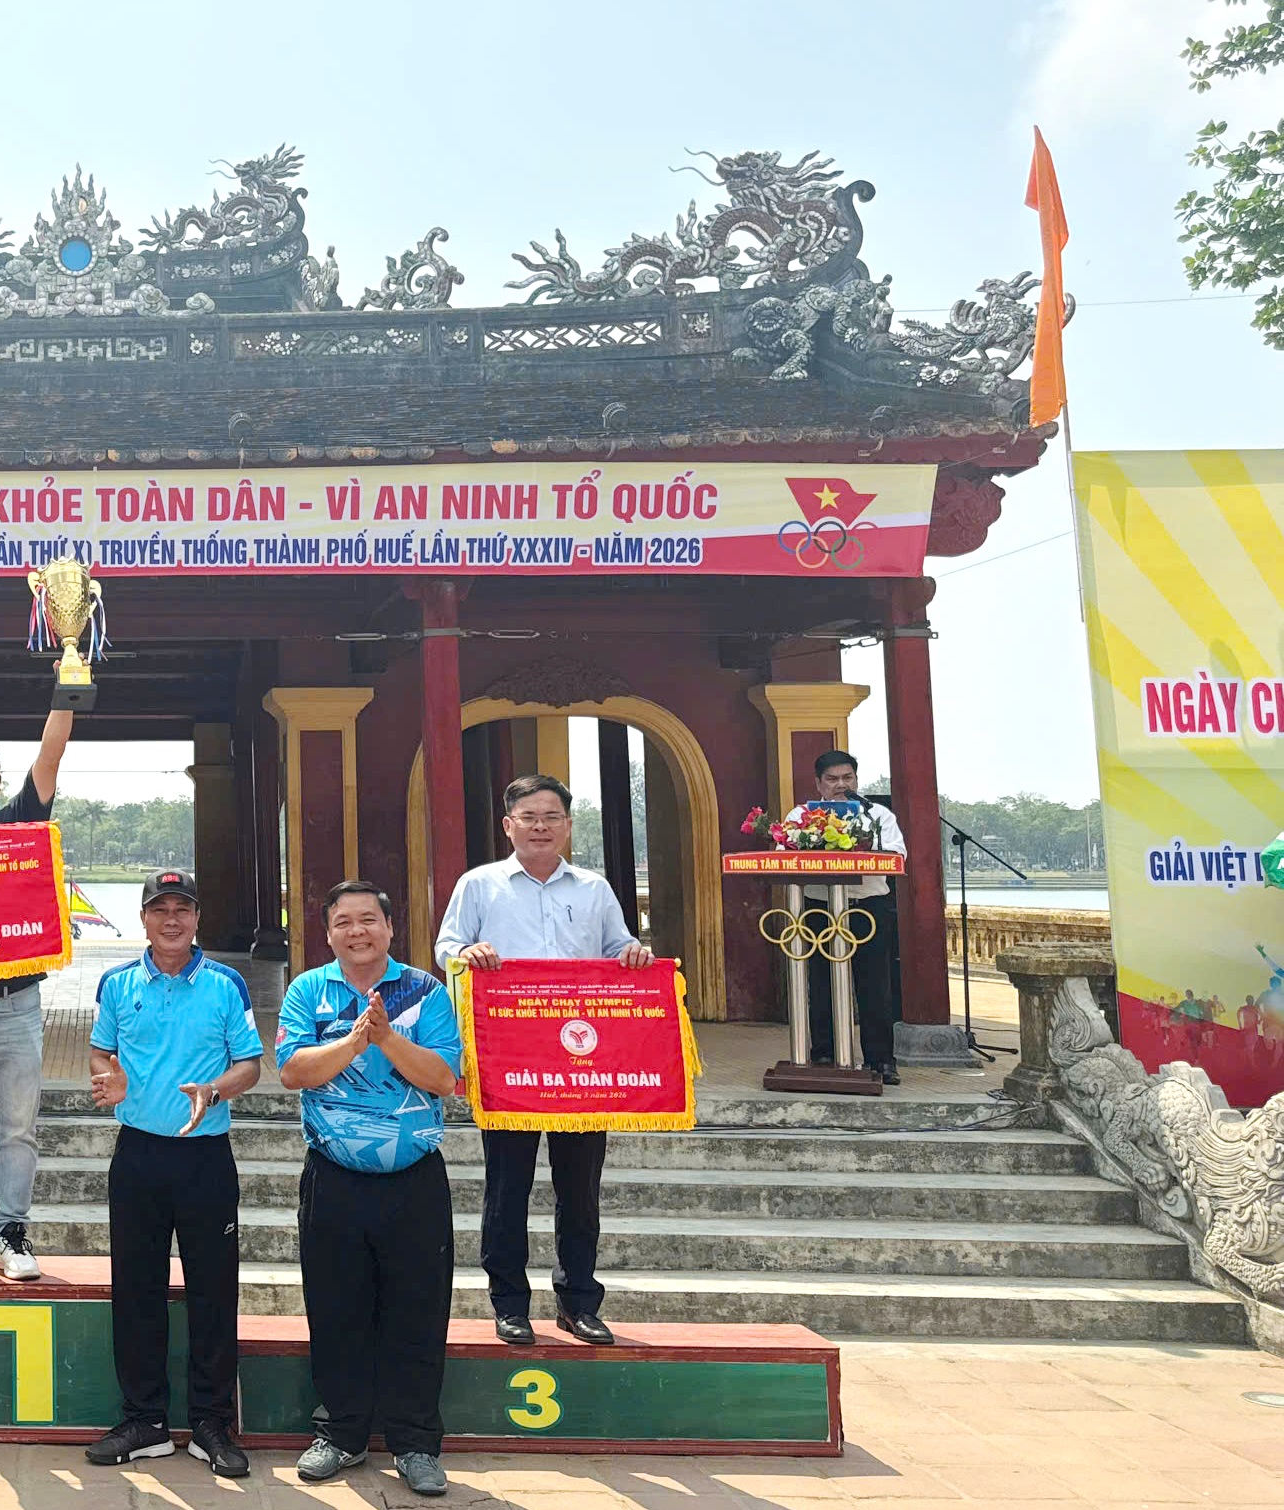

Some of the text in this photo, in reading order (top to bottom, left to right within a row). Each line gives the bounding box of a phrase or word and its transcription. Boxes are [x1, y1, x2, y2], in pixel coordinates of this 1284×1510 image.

[96, 480, 194, 522] TOÀN
[208, 479, 285, 521] DÂN
[326, 478, 361, 520] VÌ
[373, 486, 428, 520] AN
[442, 484, 538, 519] NINH
[552, 470, 601, 520] TỔ
[613, 471, 718, 523] QUỐC
[28, 535, 69, 566] THỨ
[73, 540, 92, 565] X)
[99, 531, 175, 565] TRUYỀN
[182, 530, 247, 564] THỐNG
[254, 533, 319, 564] THÀNH
[327, 529, 368, 564] PHỐ
[374, 530, 415, 563] HUẾ
[420, 529, 459, 563] LẦN
[466, 531, 508, 563] THỨ
[511, 537, 574, 564] XXXIV
[595, 532, 643, 563] NĂM
[649, 538, 701, 564] 2026
[1146, 671, 1238, 734] NGÀY
[729, 859, 758, 870] TRUNG
[760, 858, 779, 870] TÂM
[800, 859, 823, 870] THAO
[825, 858, 855, 870] THÀNH
[857, 856, 876, 870] PHỐ
[878, 856, 897, 870] HUẾ
[1150, 841, 1194, 882] GIẢI
[1204, 846, 1247, 888] VIỆT
[1, 920, 43, 939] ĐOÀN
[518, 997, 549, 1006] NGÀY
[584, 998, 633, 1006] OLYMPIC
[488, 1007, 497, 1017] VÌ
[539, 1007, 561, 1018] TOÀN
[587, 1007, 596, 1018] VÌ
[611, 1008, 630, 1018] NINH
[505, 1068, 661, 1087] GIẢI BA TOÀN ĐOÀN
[609, 1091, 627, 1099] 2026
[508, 1369, 561, 1430] 3
